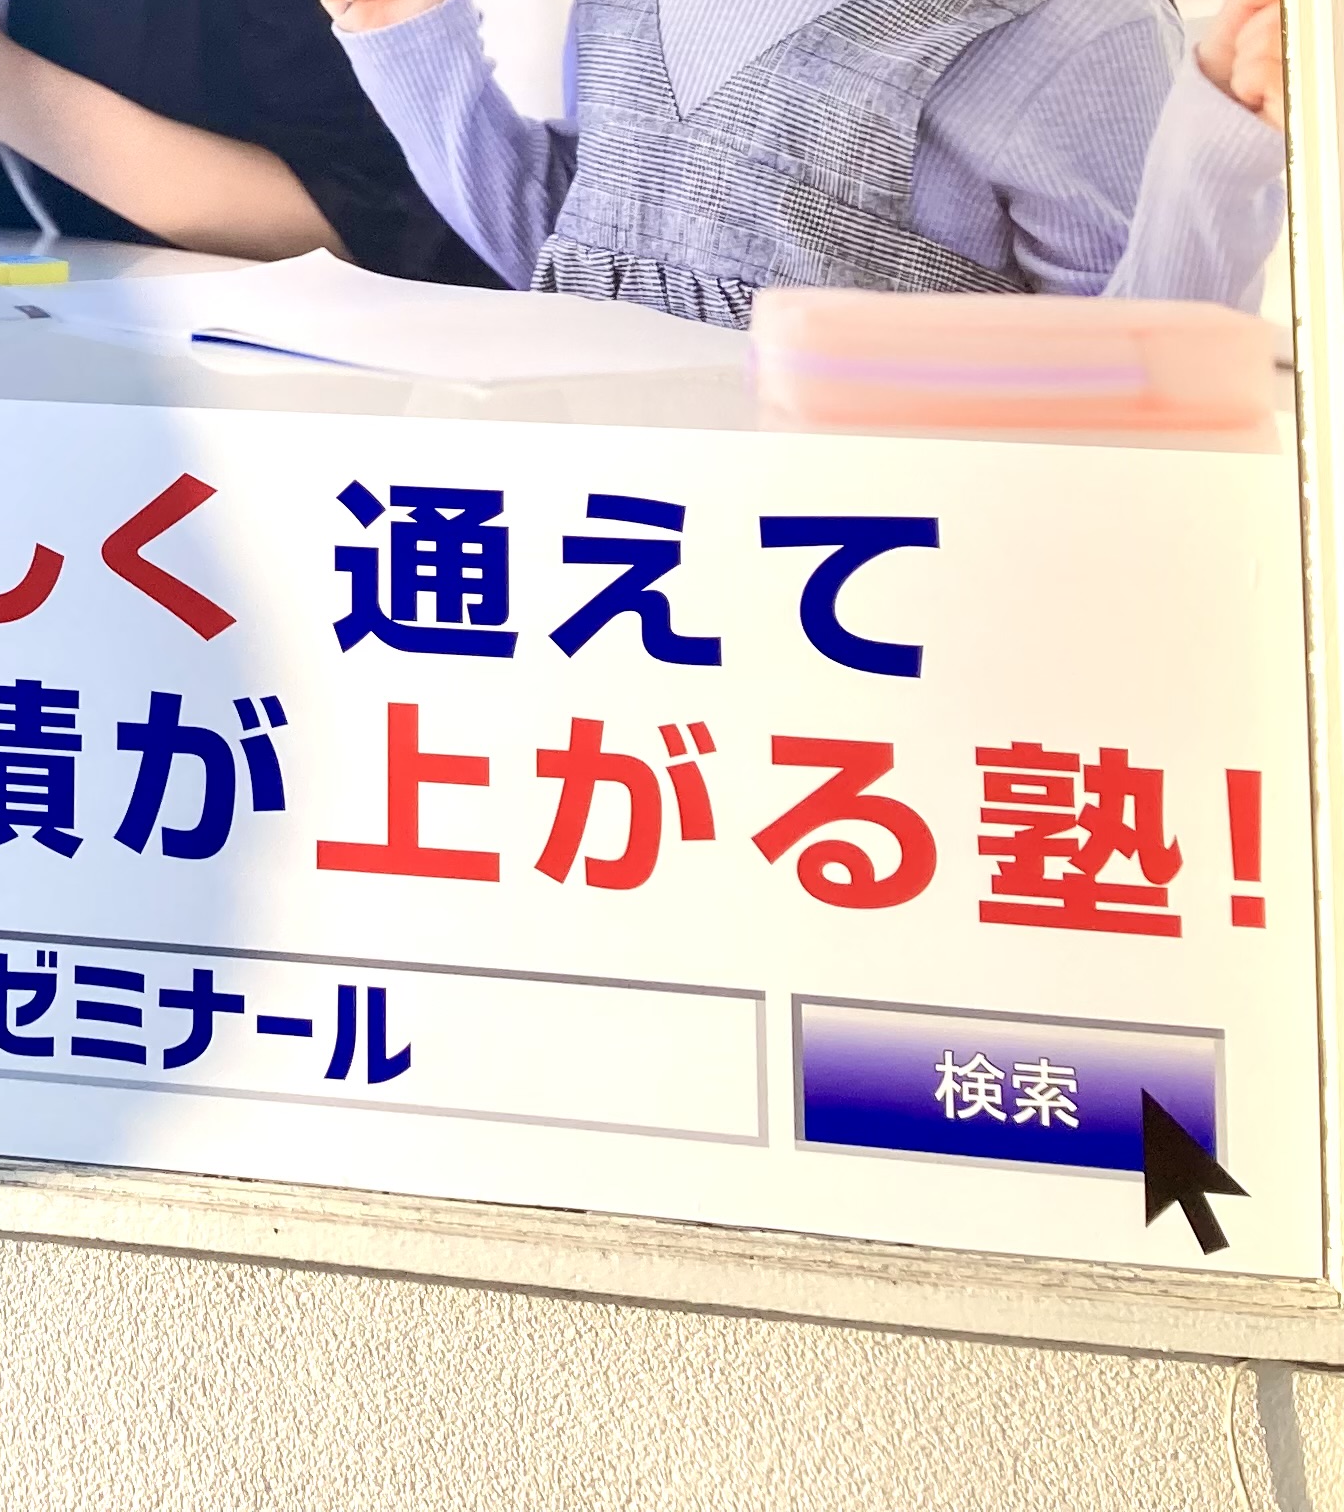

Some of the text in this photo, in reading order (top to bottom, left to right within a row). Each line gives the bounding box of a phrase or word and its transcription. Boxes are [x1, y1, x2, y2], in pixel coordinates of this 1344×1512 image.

[332, 479, 942, 679] 通えて
[932, 1048, 1080, 1131] 検索
